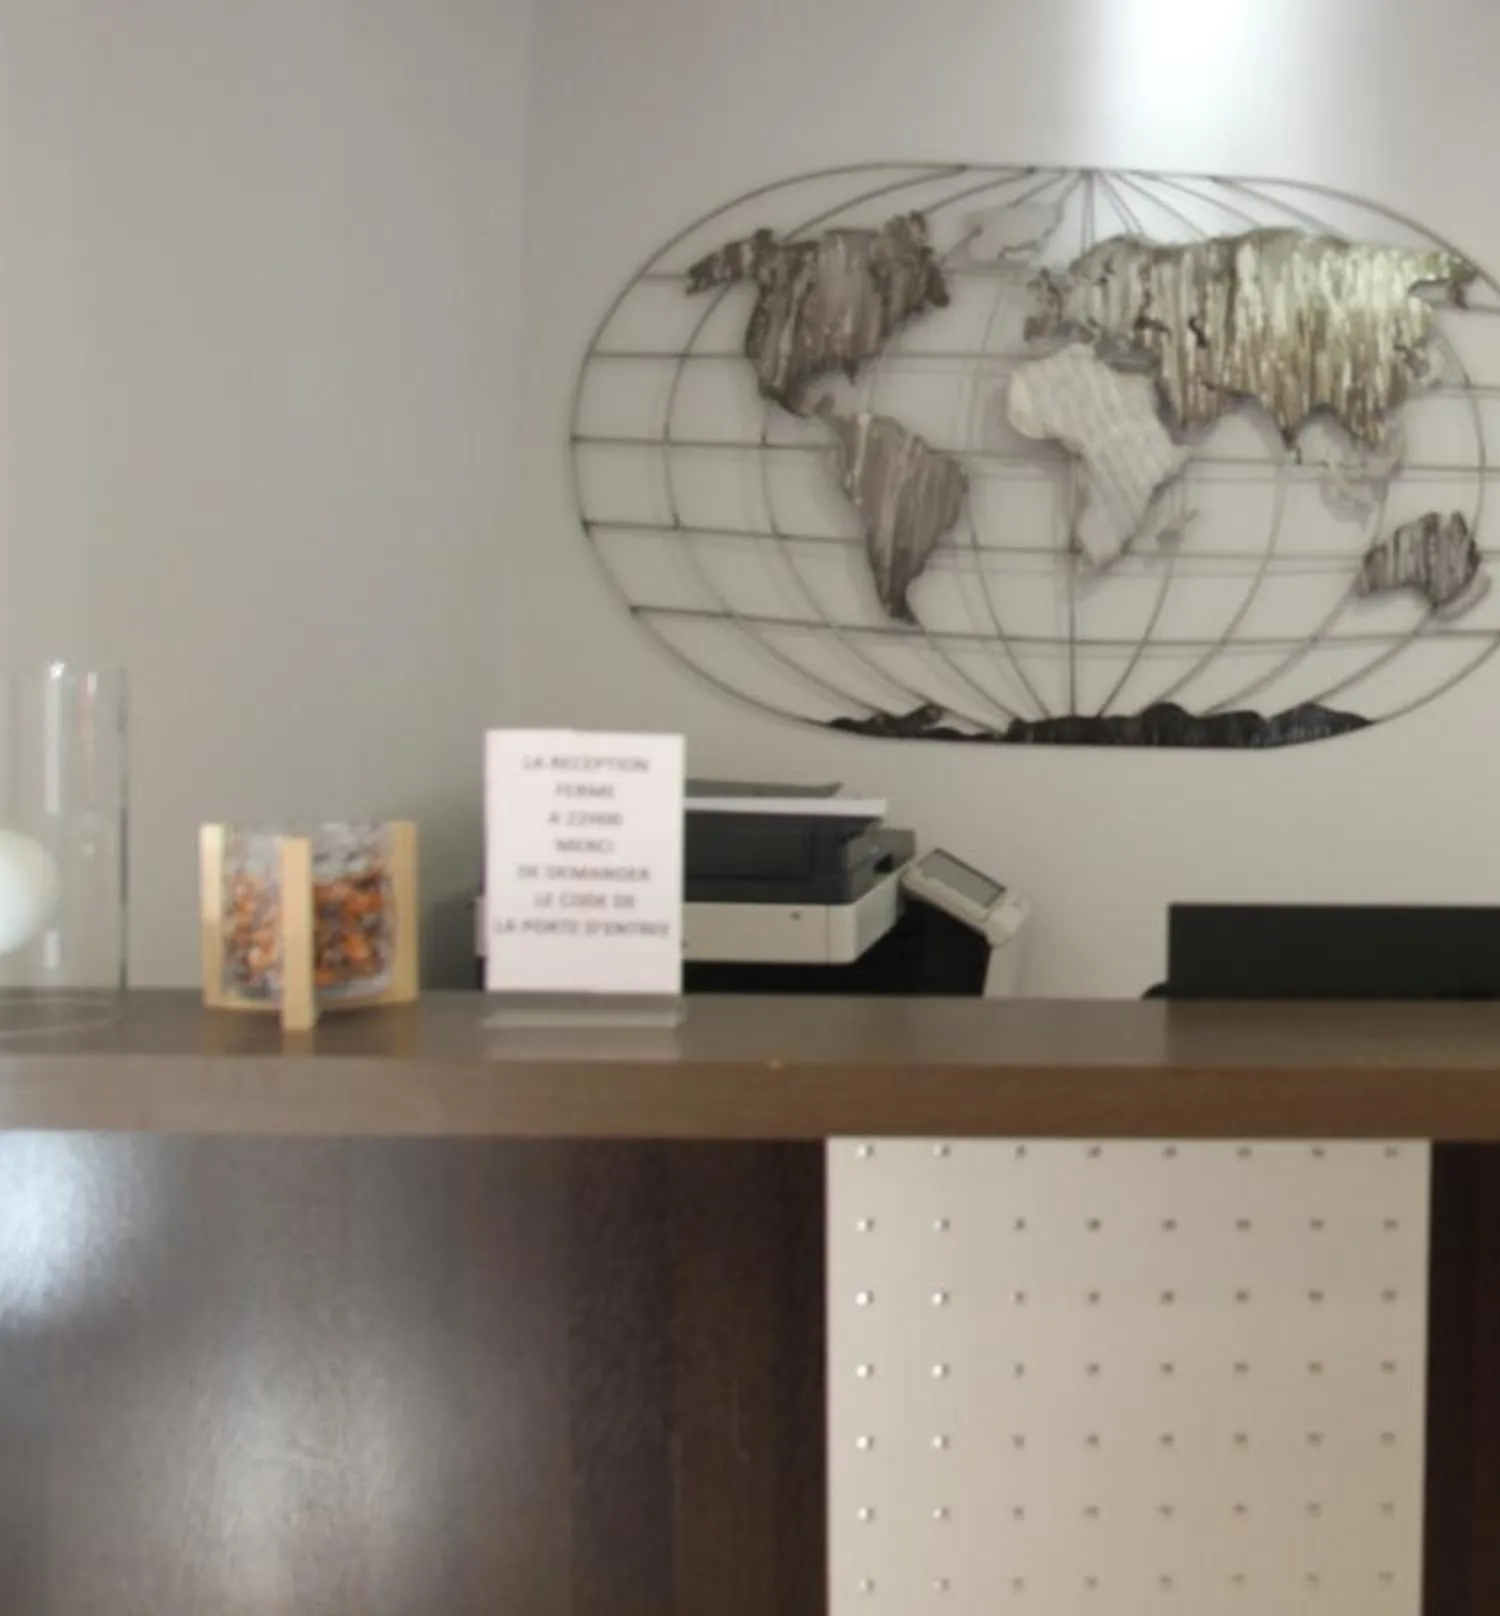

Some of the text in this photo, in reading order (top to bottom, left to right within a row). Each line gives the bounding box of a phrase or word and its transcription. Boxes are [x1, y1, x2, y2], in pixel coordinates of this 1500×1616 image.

[522, 756, 650, 772] LA RECEPTION
[547, 866, 650, 880] DEMANDER
[559, 894, 606, 908] CODE
[522, 921, 578, 934] PORTE
